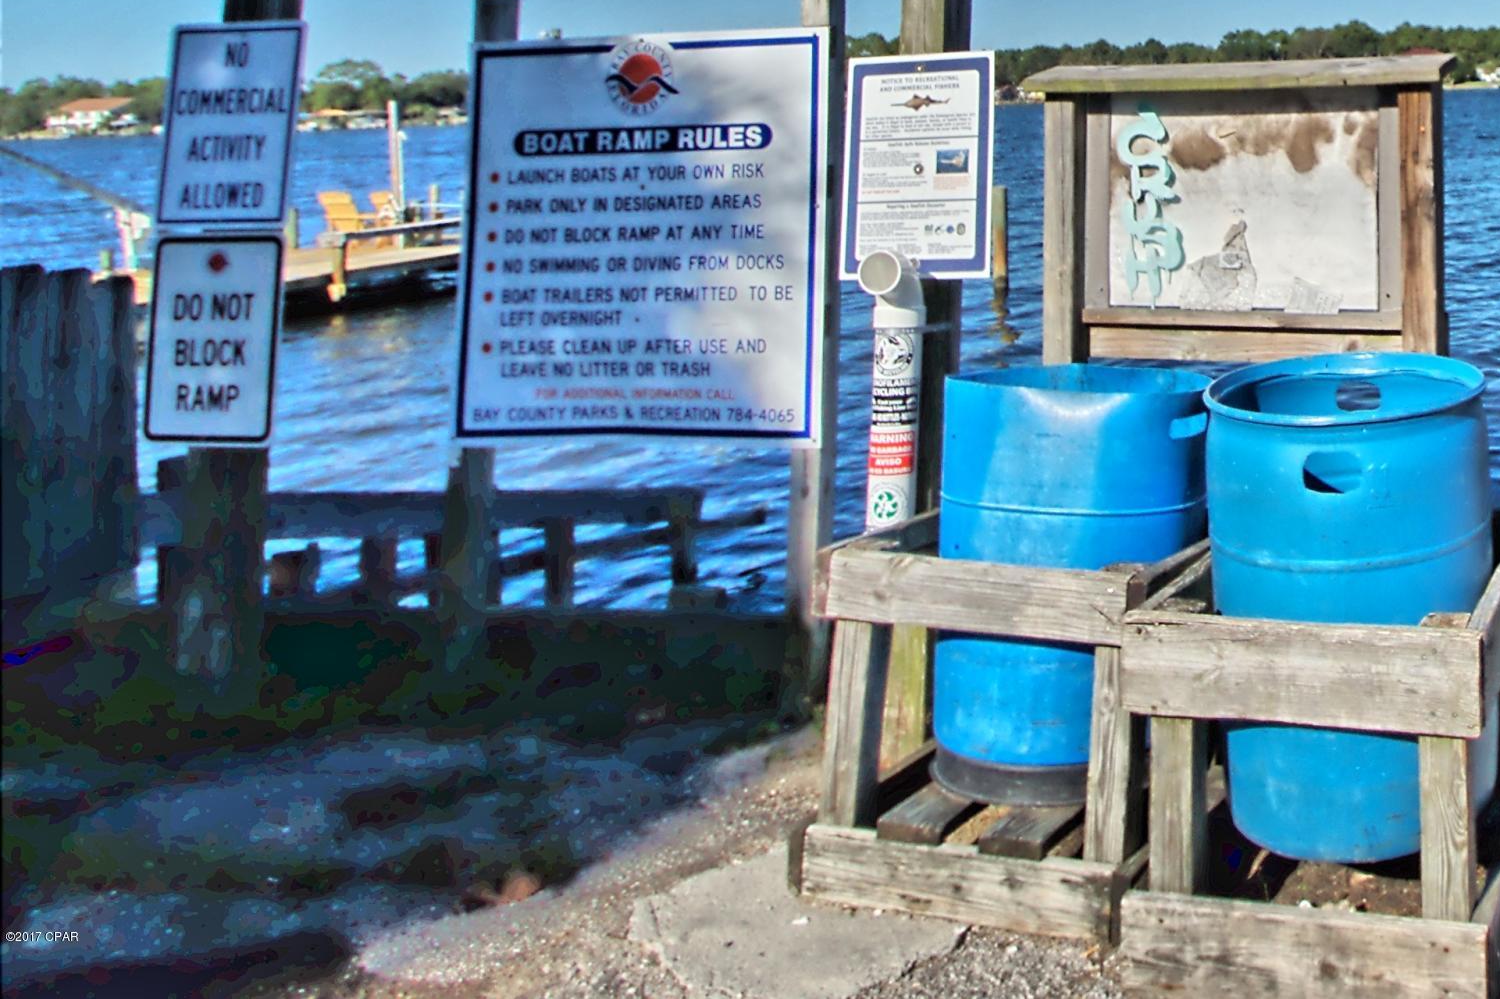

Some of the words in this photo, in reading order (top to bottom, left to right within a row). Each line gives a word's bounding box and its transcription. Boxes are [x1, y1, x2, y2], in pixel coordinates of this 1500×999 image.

[225, 42, 249, 67] NO
[175, 87, 287, 115] COMMERCIAL
[187, 135, 266, 162] ACTIVITY
[523, 132, 589, 153] BOAT
[596, 129, 671, 151] RAMP
[677, 125, 763, 150] RULES
[507, 168, 565, 185] LAUNCH
[571, 166, 617, 183] BOATS
[622, 166, 641, 181] AT
[648, 165, 686, 181] YOUR
[693, 164, 724, 180] OWN
[732, 163, 764, 178] RISK
[180, 183, 264, 209] ALLOWED
[506, 198, 543, 214] PARK
[550, 197, 587, 213] ONLY
[593, 197, 608, 212] IN
[614, 194, 703, 212] DESIGNATED
[711, 193, 762, 209] AREAS
[504, 228, 525, 244] DO
[530, 227, 557, 243] NOT
[564, 226, 611, 243] BLOCK
[618, 225, 660, 241] RAMP
[666, 225, 684, 240] AT
[691, 224, 723, 240] ANY
[731, 223, 764, 239] TIME
[502, 258, 523, 274] NO
[529, 257, 600, 274] SWIMMING
[607, 257, 627, 272] OR
[633, 256, 681, 272] DIVING
[688, 255, 729, 270] FROM
[736, 254, 785, 270] DOCKS
[502, 288, 537, 304] BOAT
[544, 287, 613, 304] TRAILERS
[619, 286, 648, 302] NOT
[655, 286, 737, 302] PERMITTED
[749, 285, 767, 301] TO
[774, 285, 793, 300] BE
[173, 293, 203, 321] DO
[211, 293, 255, 321] NOT
[500, 311, 535, 327] LEFT
[541, 310, 622, 327] OVERNIGHT
[174, 339, 247, 367] BLOCK
[500, 340, 555, 355] PLEASE
[563, 339, 611, 355] CLEAN
[617, 339, 637, 354] UP
[645, 338, 692, 354] AFTER
[699, 338, 728, 354] USE
[735, 338, 767, 353] AND
[501, 362, 547, 378] LEAVE
[553, 362, 573, 377] NO
[580, 361, 629, 377] LITTER
[636, 361, 654, 377] OR
[662, 361, 711, 377] TRASH
[176, 384, 240, 412] RAMP
[563, 387, 626, 399] ADDITIONAL
[632, 387, 702, 399] INFORMATION
[473, 408, 500, 422] BAY
[508, 407, 566, 421] COUNTY
[572, 406, 618, 420] PARKS
[641, 406, 720, 421] RECREATION
[727, 407, 795, 423] 784-4065
